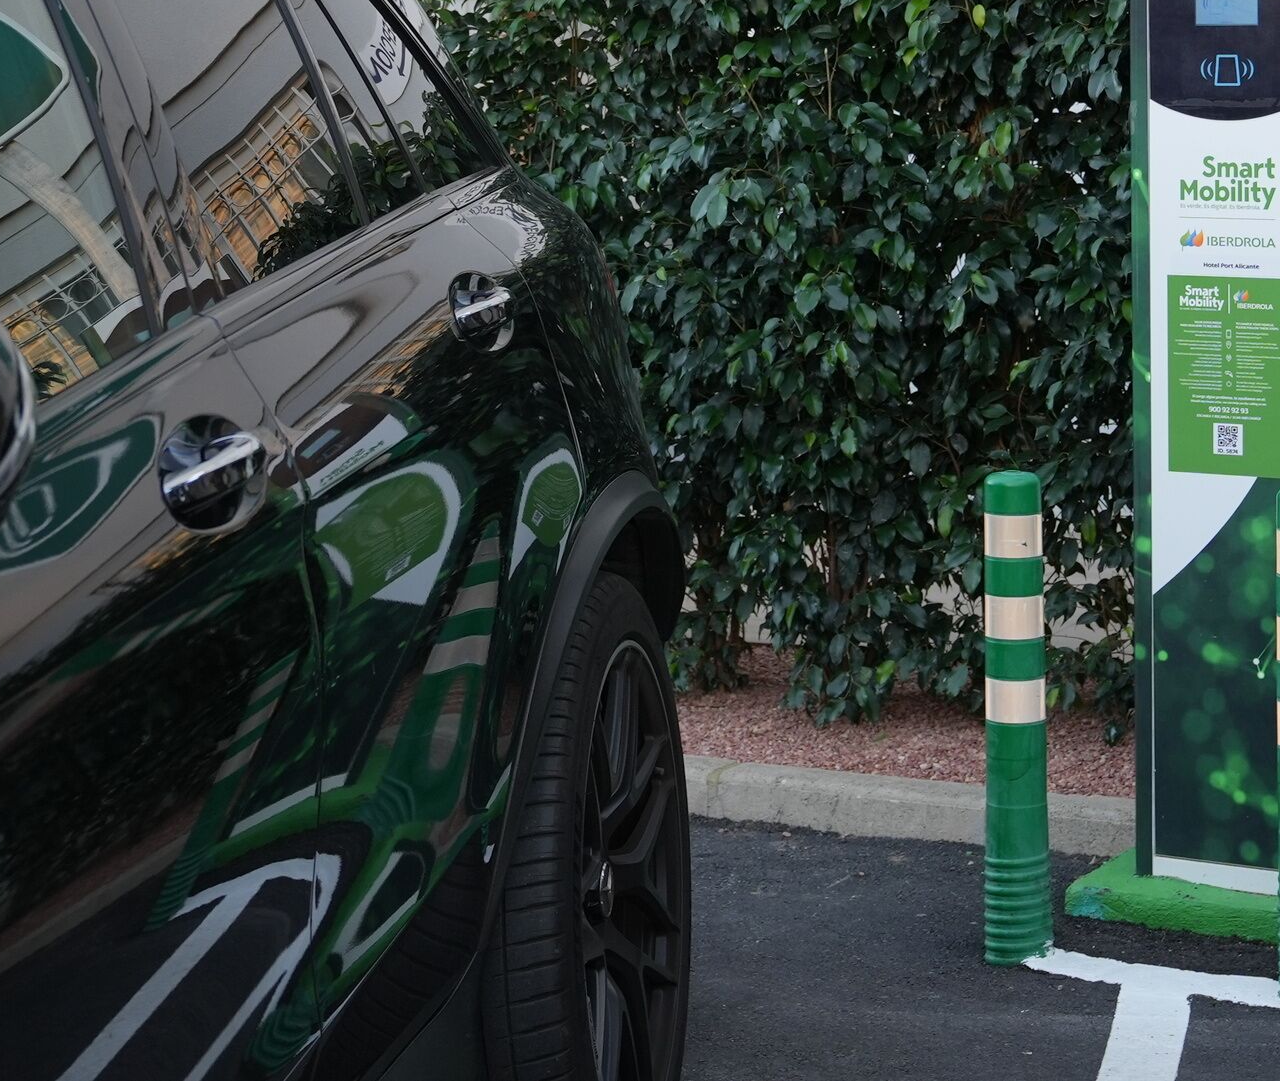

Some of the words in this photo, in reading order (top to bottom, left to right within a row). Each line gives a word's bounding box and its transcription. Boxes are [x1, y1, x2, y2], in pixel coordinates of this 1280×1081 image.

[1202, 155, 1276, 179] Smart
[1179, 179, 1276, 210] Mobility
[1207, 235, 1276, 249] IBERDROLA
[1184, 284, 1219, 297] Smart
[1179, 296, 1225, 311] Mobility
